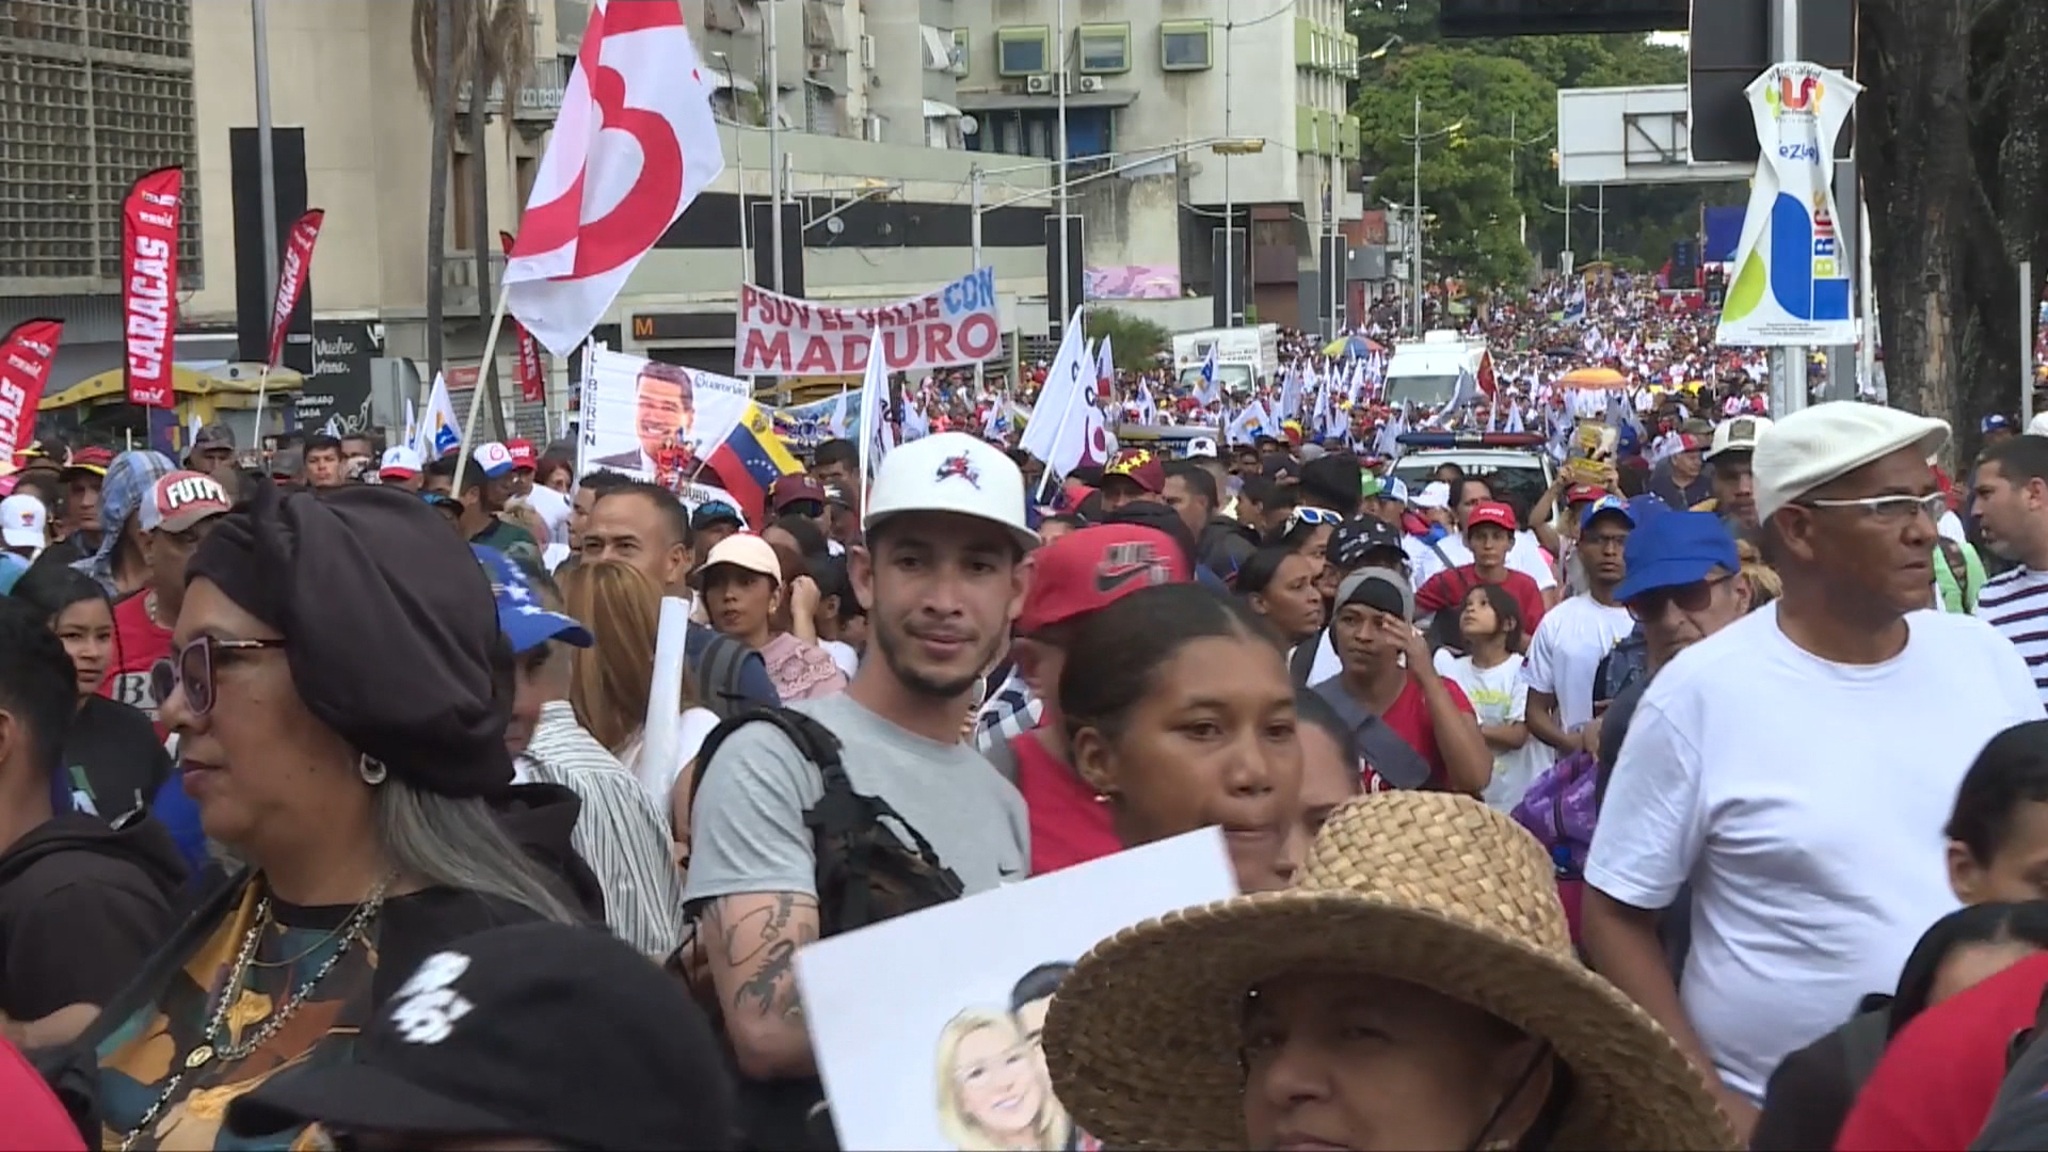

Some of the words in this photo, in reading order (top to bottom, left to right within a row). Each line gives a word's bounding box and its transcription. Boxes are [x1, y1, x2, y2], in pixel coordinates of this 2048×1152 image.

[127, 236, 169, 380] CARACAS
[635, 317, 654, 336] M
[742, 284, 809, 328] PSUV
[944, 266, 995, 315] CON
[742, 312, 998, 373] MADURO
